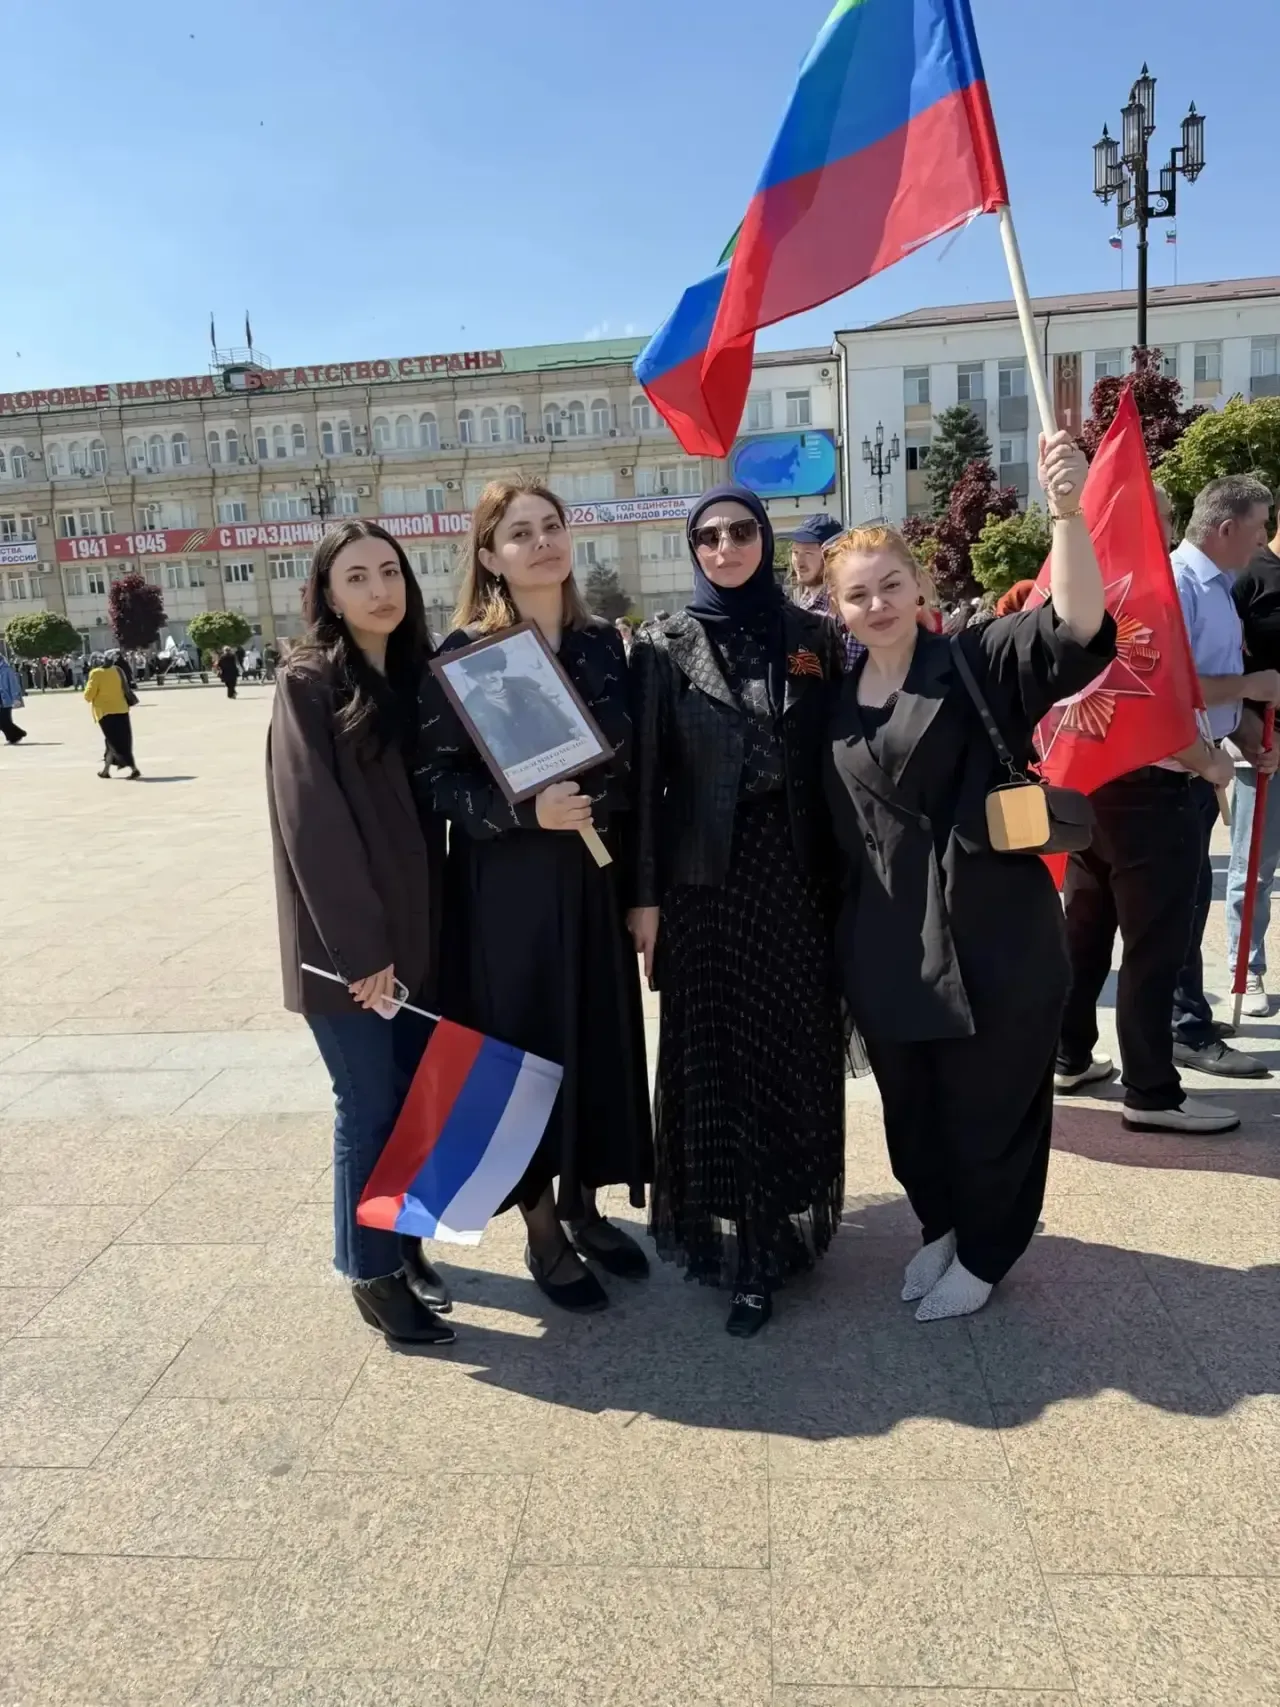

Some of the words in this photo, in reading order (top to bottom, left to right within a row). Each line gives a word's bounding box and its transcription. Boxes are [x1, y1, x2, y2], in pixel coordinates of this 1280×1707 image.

[117, 376, 217, 400] НАРОДА
[398, 350, 502, 375] СТРАНЫ
[1063, 408, 1072, 427] 1
[616, 504, 634, 512] ГОД
[637, 499, 686, 510] ЕДИНСТВА
[616, 510, 660, 520] НАРОДОВ
[662, 507, 690, 518] РОСС
[68, 538, 108, 559] 1941
[126, 533, 167, 553] 1945
[220, 529, 232, 547] С
[236, 522, 334, 546] ПРАЗДНИК
[367, 514, 434, 537] ЛИКОЙ
[438, 513, 472, 533] ПОБ
[2, 554, 37, 563] РОССИИ
